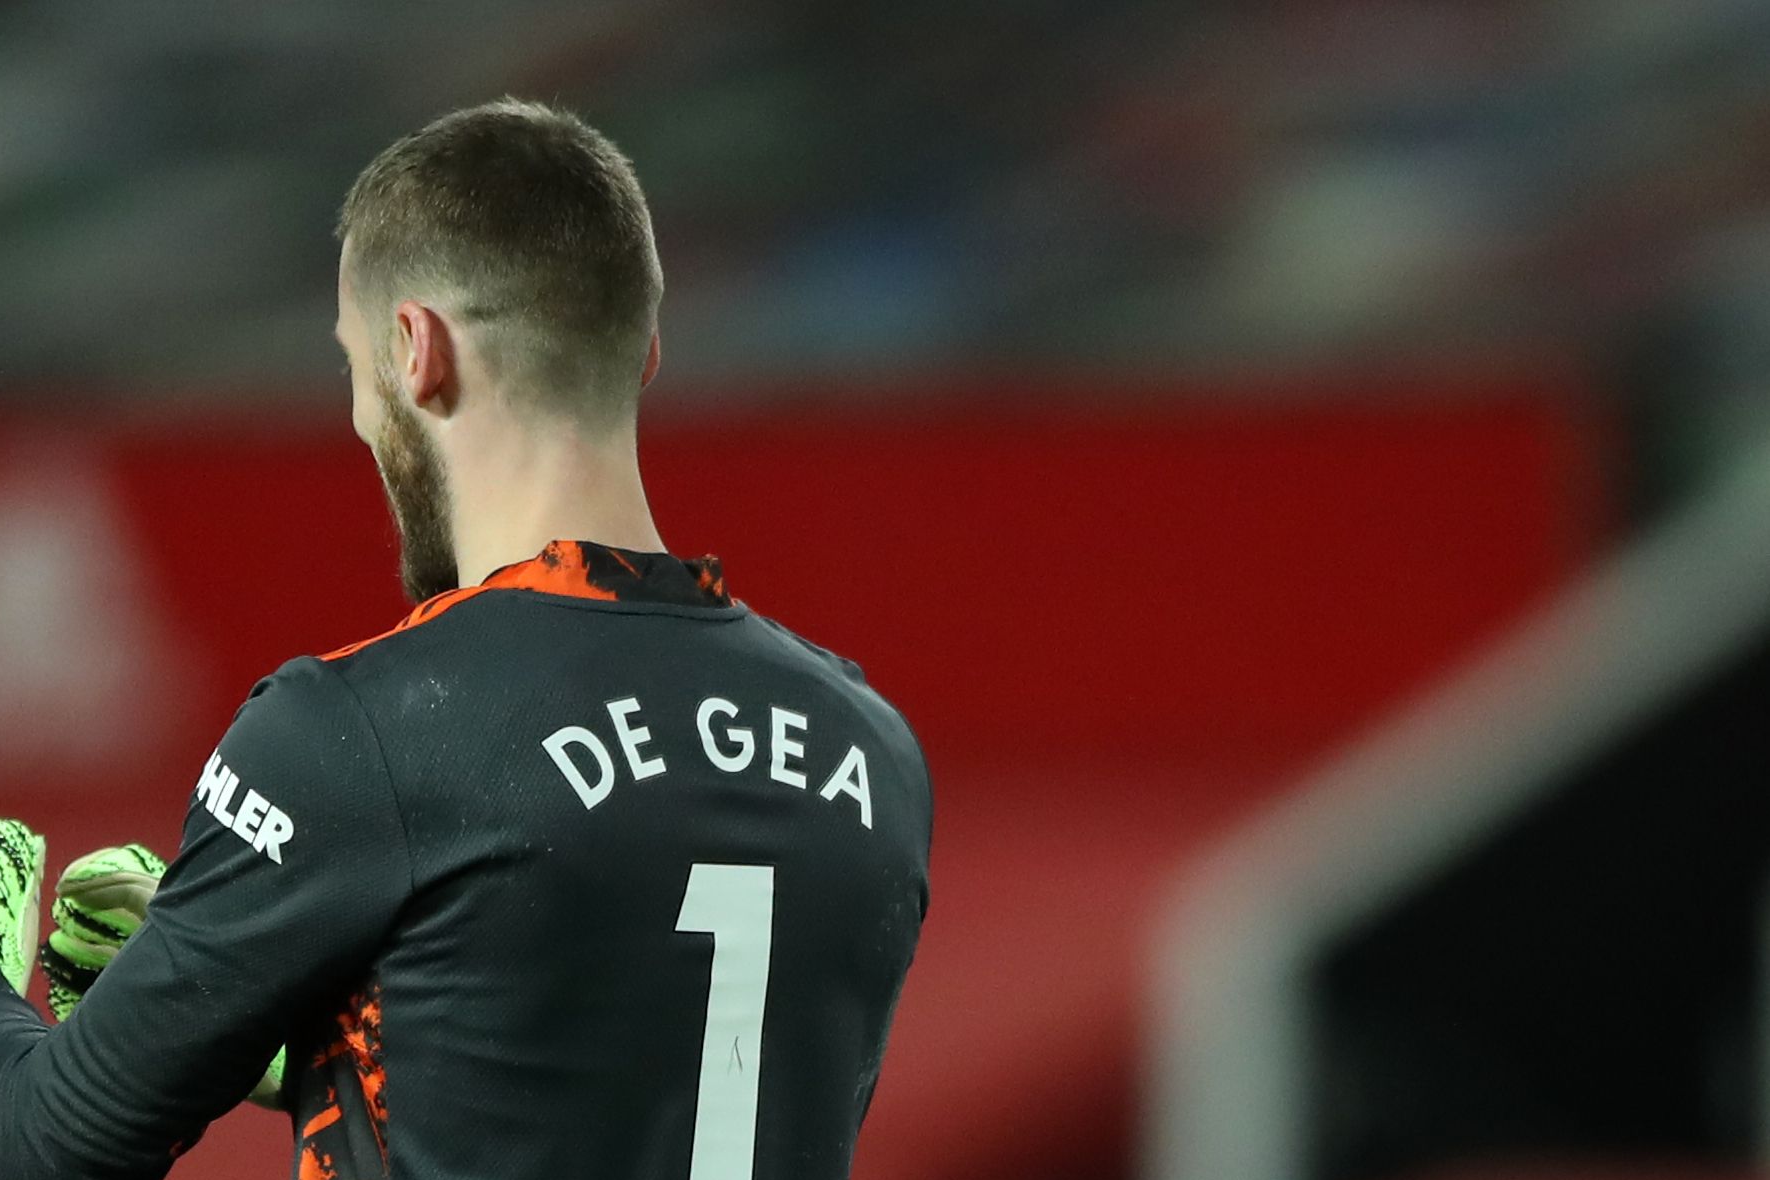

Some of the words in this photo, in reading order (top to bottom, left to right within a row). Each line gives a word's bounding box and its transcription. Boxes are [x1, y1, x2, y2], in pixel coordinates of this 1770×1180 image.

[195, 747, 295, 865] HLER
[540, 697, 667, 810] DE
[695, 697, 873, 830] GEA
